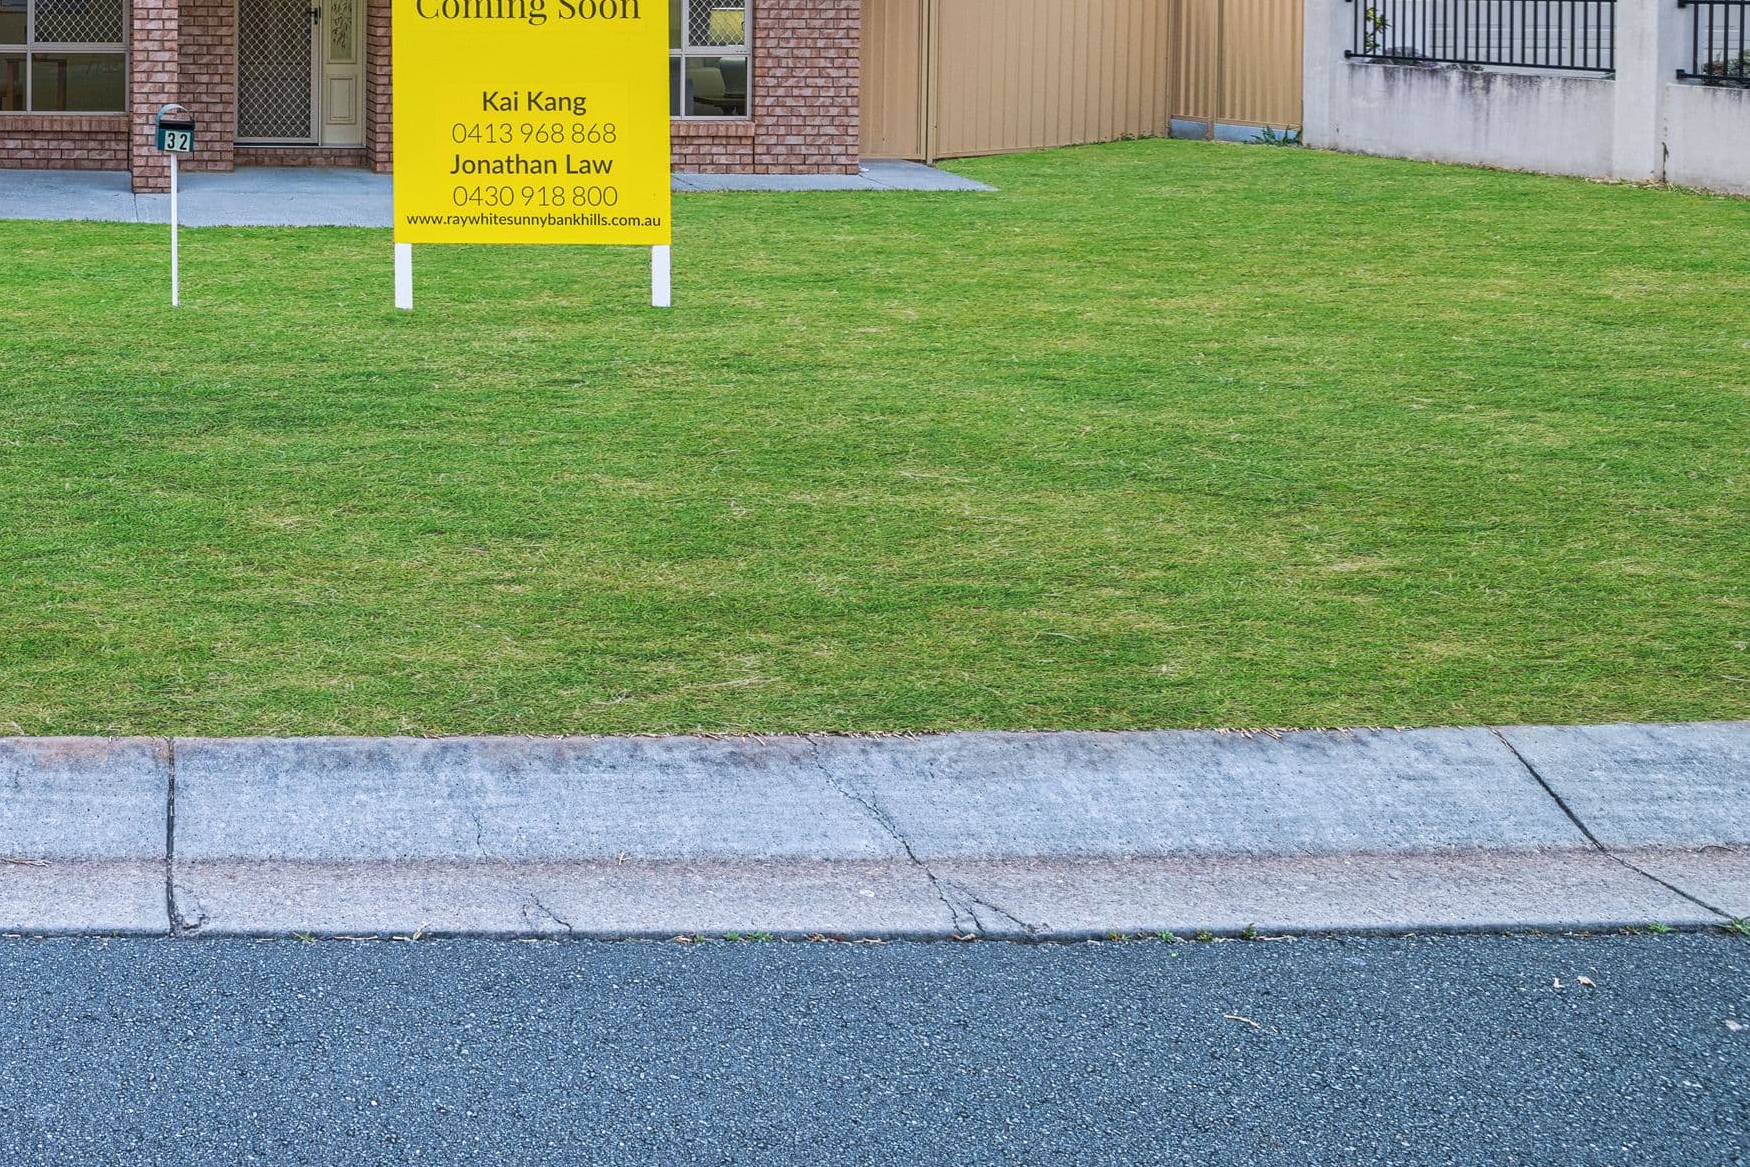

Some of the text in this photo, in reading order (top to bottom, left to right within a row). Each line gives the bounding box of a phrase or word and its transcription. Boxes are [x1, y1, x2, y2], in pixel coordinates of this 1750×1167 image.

[482, 90, 587, 117] Kai Kang
[167, 132, 188, 150] 32
[451, 122, 617, 144] 0413 968 868
[449, 153, 614, 175] Jonathan Law
[452, 185, 618, 207] 0430 918 800
[406, 212, 661, 229] www.raywhitesunnybankhills.com.au
